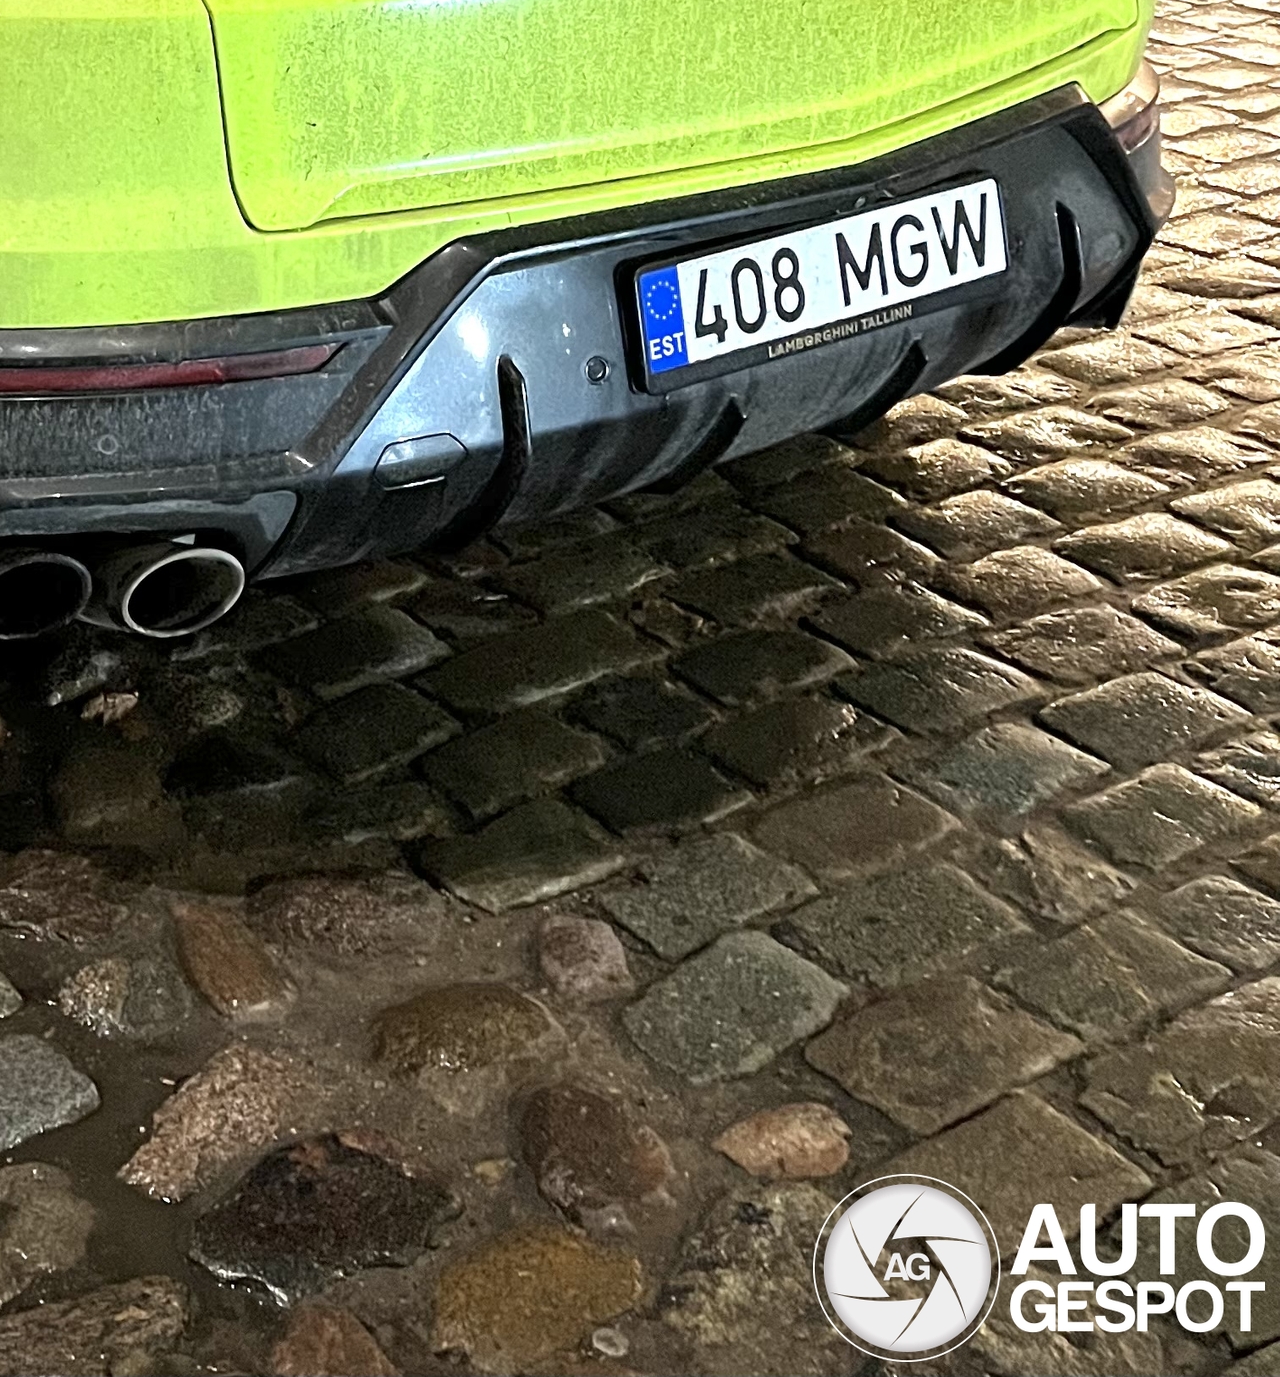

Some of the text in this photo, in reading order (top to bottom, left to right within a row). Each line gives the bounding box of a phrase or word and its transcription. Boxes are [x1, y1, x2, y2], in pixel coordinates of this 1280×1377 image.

[695, 192, 988, 344] 408 MGW
[649, 331, 685, 361] EST
[767, 303, 913, 359] LAMBORGHINI TALLINN
